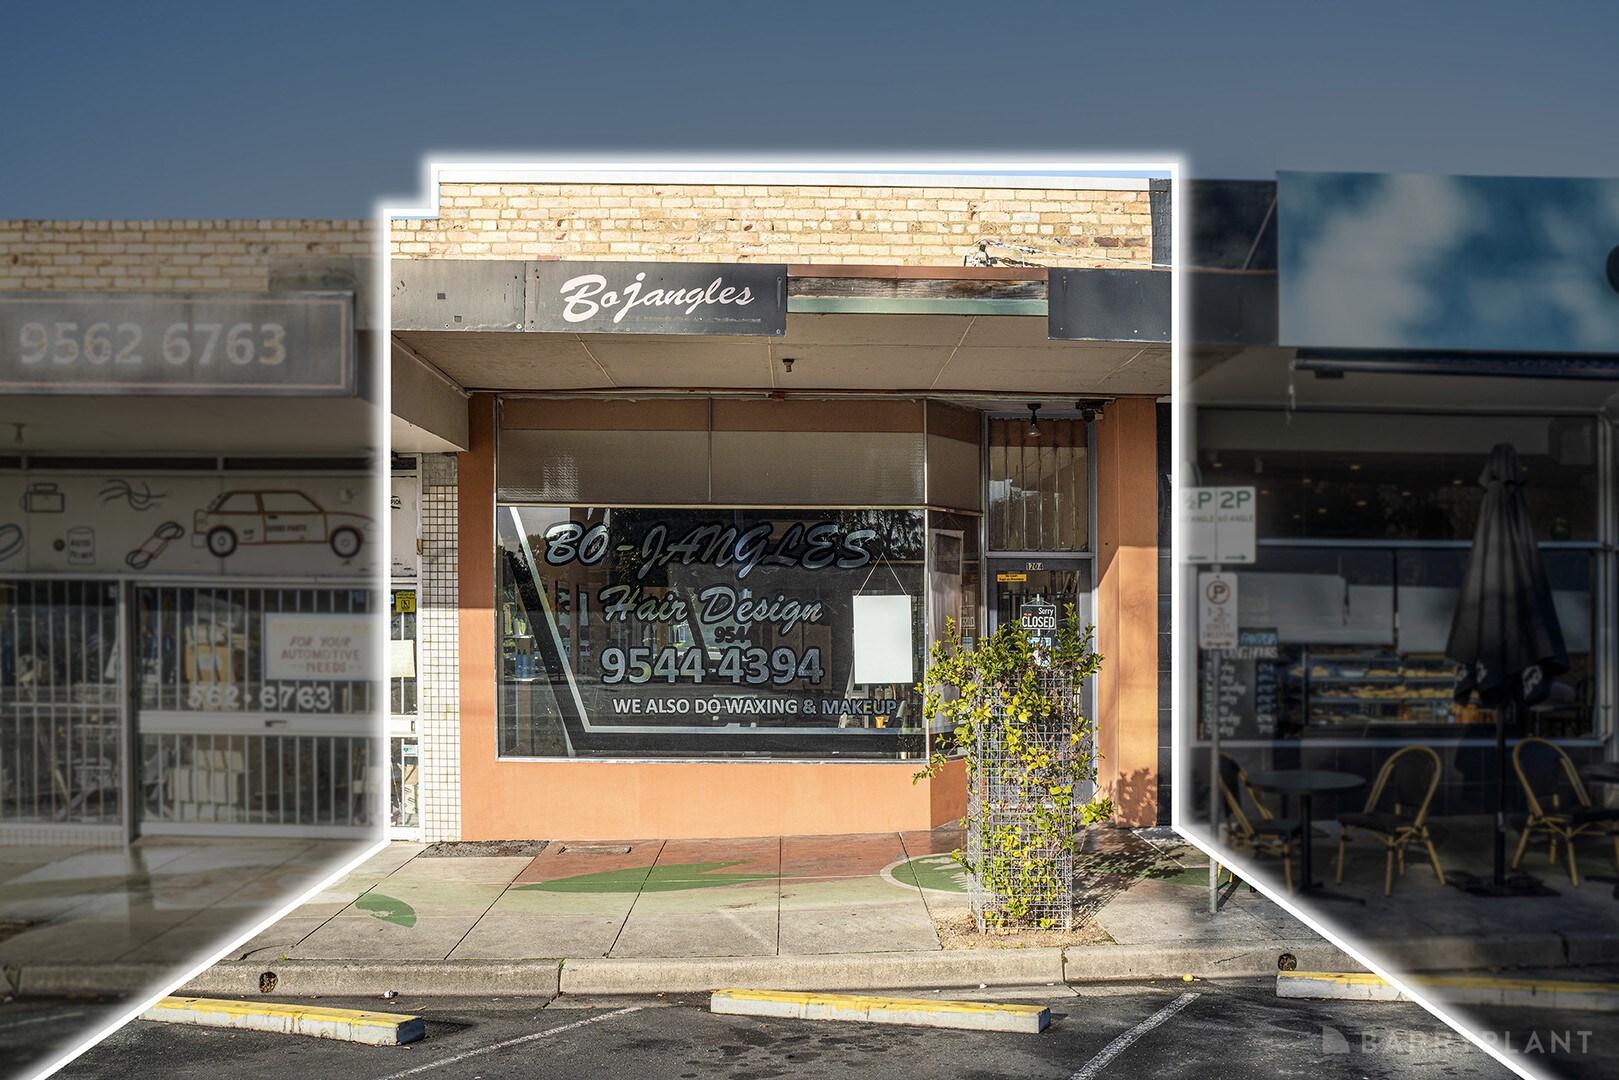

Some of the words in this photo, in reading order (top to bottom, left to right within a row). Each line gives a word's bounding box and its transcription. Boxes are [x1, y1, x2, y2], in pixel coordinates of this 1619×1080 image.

[560, 272, 755, 324] Bojangles
[19, 321, 143, 366] 9562
[162, 321, 287, 366] 6763
[1220, 490, 1252, 509] 2P
[600, 585, 688, 622] Hair
[700, 585, 823, 635] Design
[1038, 607, 1054, 616] Sorry
[1022, 616, 1055, 628] CLOSED
[289, 636, 313, 647] FOR
[320, 636, 352, 648] YOUR
[280, 648, 361, 660] AUTOMOTIVE
[305, 661, 347, 673] NEEDS
[601, 648, 705, 684] 9544
[718, 648, 824, 684] 4394
[613, 698, 641, 714] WE
[646, 698, 690, 714] ALSO
[695, 698, 720, 714] DO
[725, 698, 798, 714] WAXING
[803, 699, 817, 714] &
[822, 699, 897, 715] MAKEUP
